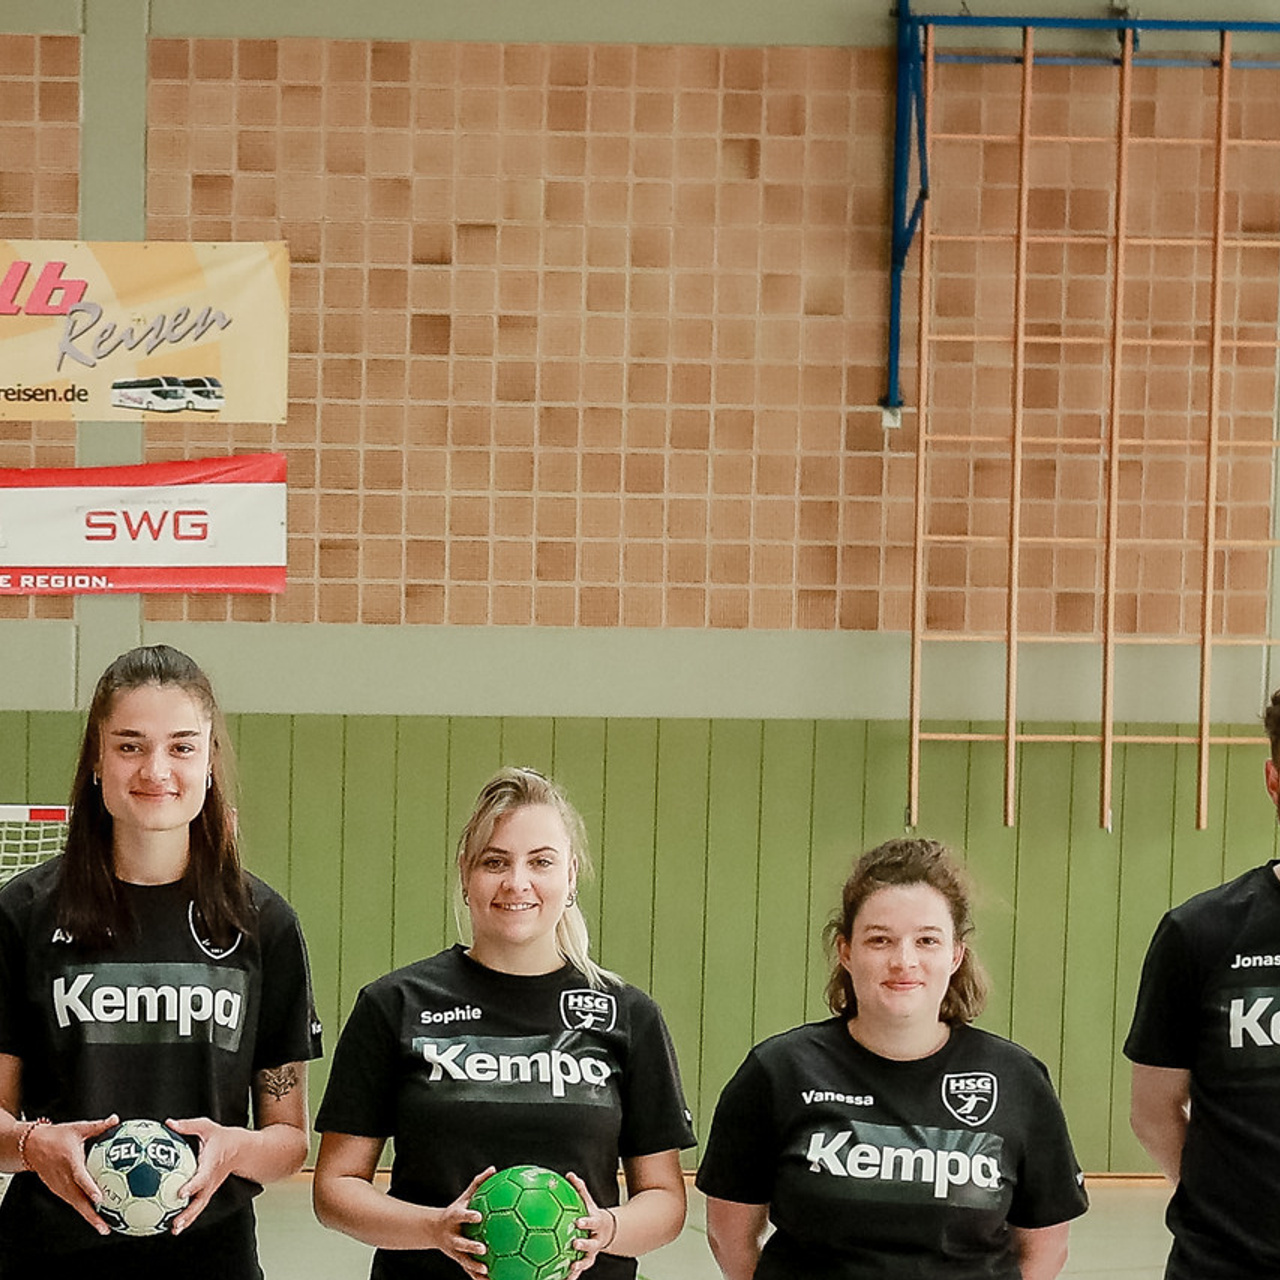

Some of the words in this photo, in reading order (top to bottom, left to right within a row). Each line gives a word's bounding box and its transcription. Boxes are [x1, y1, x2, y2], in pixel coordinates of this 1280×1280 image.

[57, 302, 233, 372] Reisen
[85, 510, 209, 541] SWG
[20, 574, 114, 589] REGION.
[1231, 954, 1280, 969] Jonas
[53, 973, 241, 1036] Kempa
[568, 994, 609, 1011] HSG
[421, 1005, 482, 1025] Sophie
[423, 1043, 611, 1098] Kempa
[950, 1078, 992, 1090] HSG
[802, 1089, 874, 1106] Vanessa
[109, 1142, 179, 1167] SELECT
[806, 1130, 1002, 1198] Kempa
